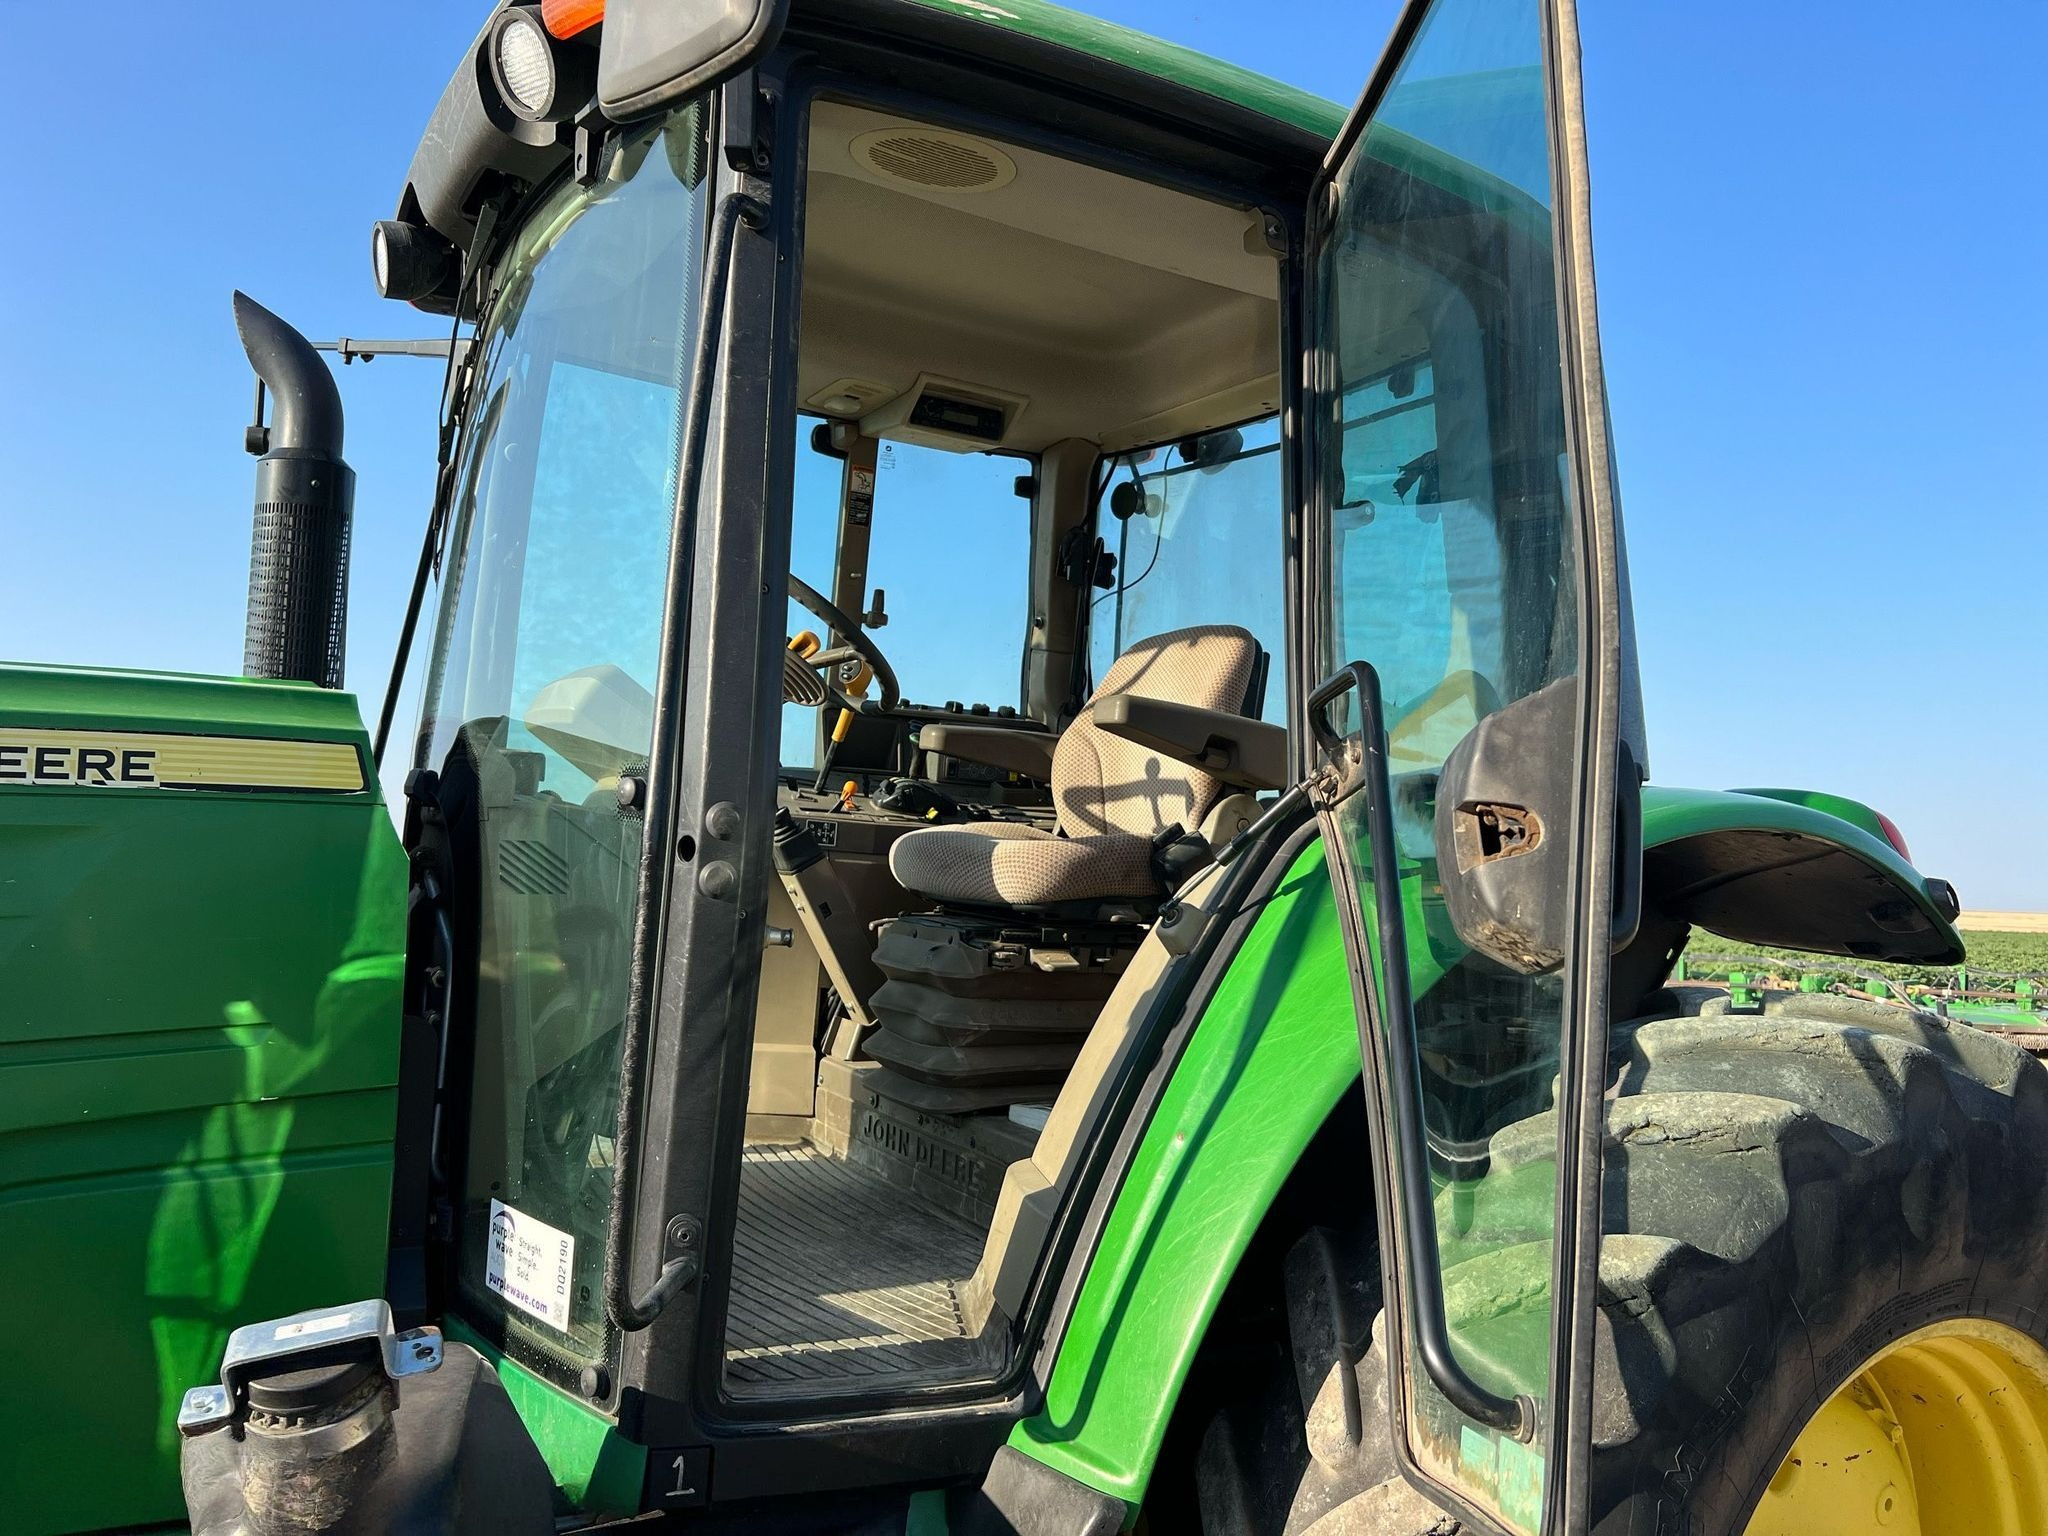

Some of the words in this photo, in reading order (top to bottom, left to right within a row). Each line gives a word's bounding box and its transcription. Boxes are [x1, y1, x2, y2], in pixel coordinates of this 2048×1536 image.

[864, 1115, 909, 1157] JOHN
[492, 1221, 514, 1241] purple
[497, 1239, 513, 1257] wave
[489, 1272, 548, 1314] purplewave.com
[665, 1455, 696, 1497] 1
